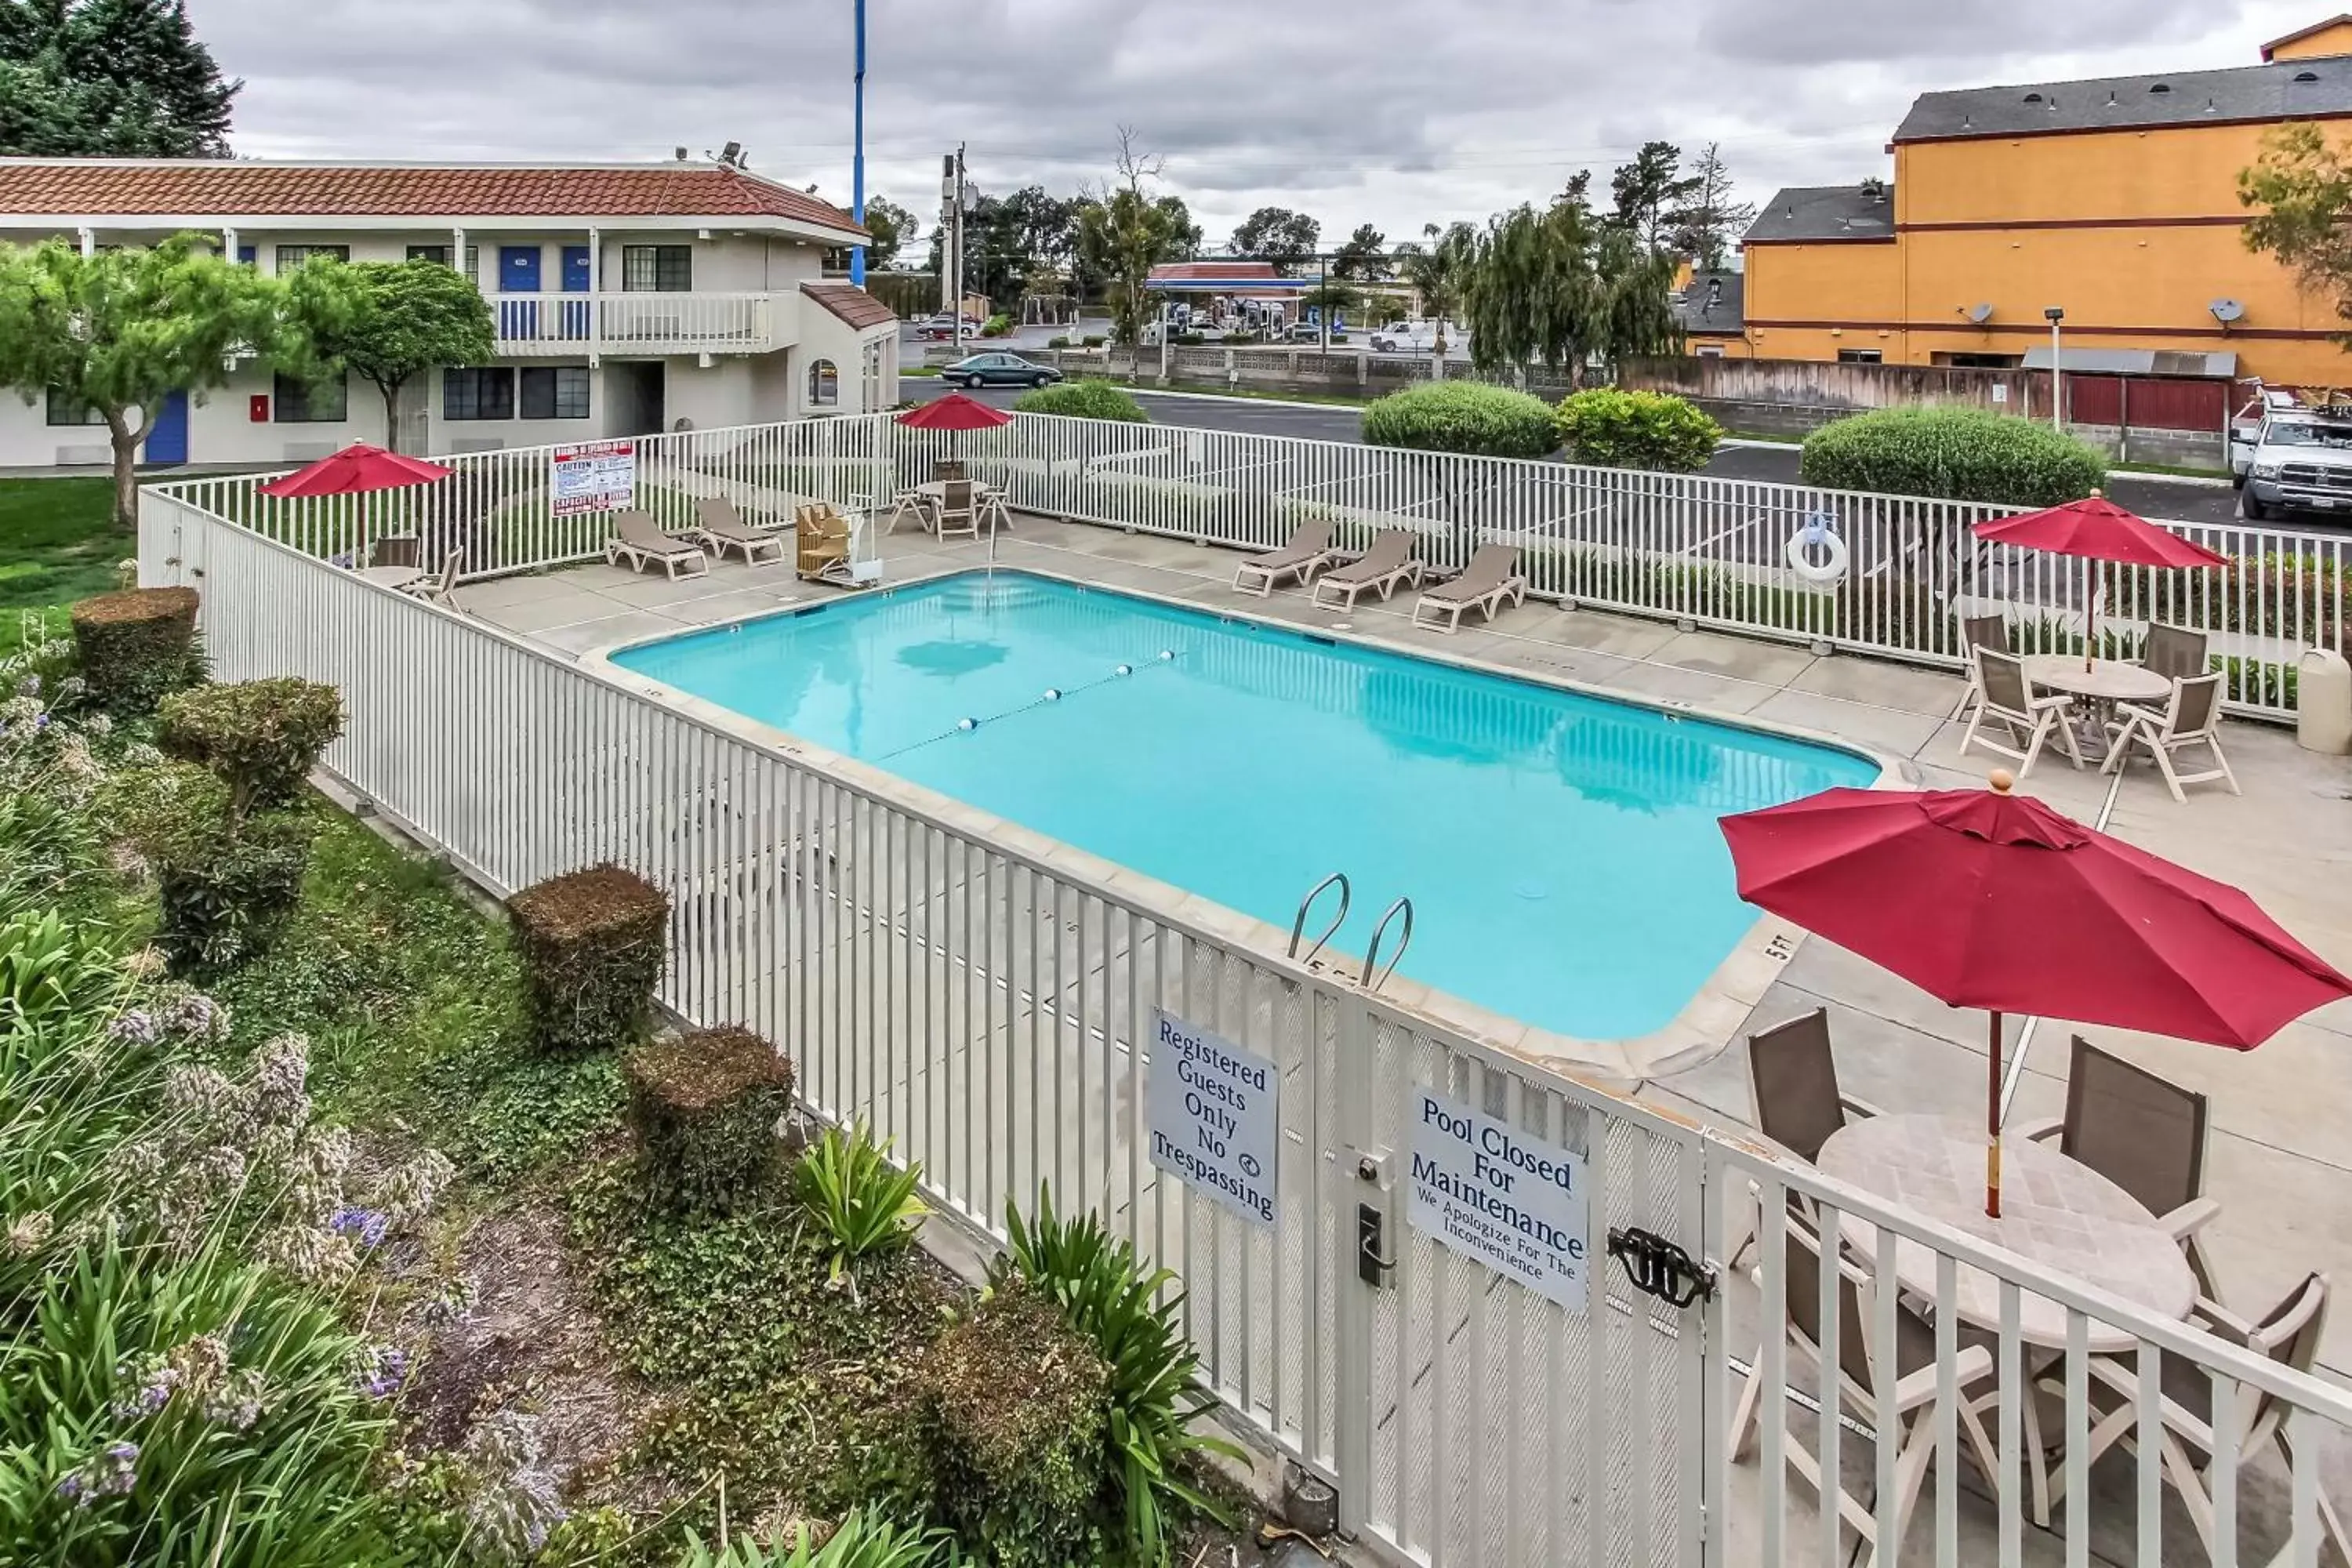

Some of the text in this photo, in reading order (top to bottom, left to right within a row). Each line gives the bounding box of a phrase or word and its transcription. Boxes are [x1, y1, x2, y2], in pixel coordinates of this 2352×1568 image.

[556, 461, 592, 471] CAUTION
[1766, 949, 1788, 960] 5
[1160, 1020, 1265, 1091] Registered
[1178, 1059, 1246, 1111] Guests
[1185, 1092, 1236, 1139] Only
[1197, 1125, 1225, 1159] No
[1423, 1097, 1572, 1192] Pool Closed
[1153, 1130, 1274, 1221] Trespassing
[1473, 1151, 1515, 1193] For
[1411, 1152, 1584, 1260] Maintenance
[1417, 1185, 1575, 1280] We Apologize For The
[1444, 1216, 1544, 1280] Inconvenience
